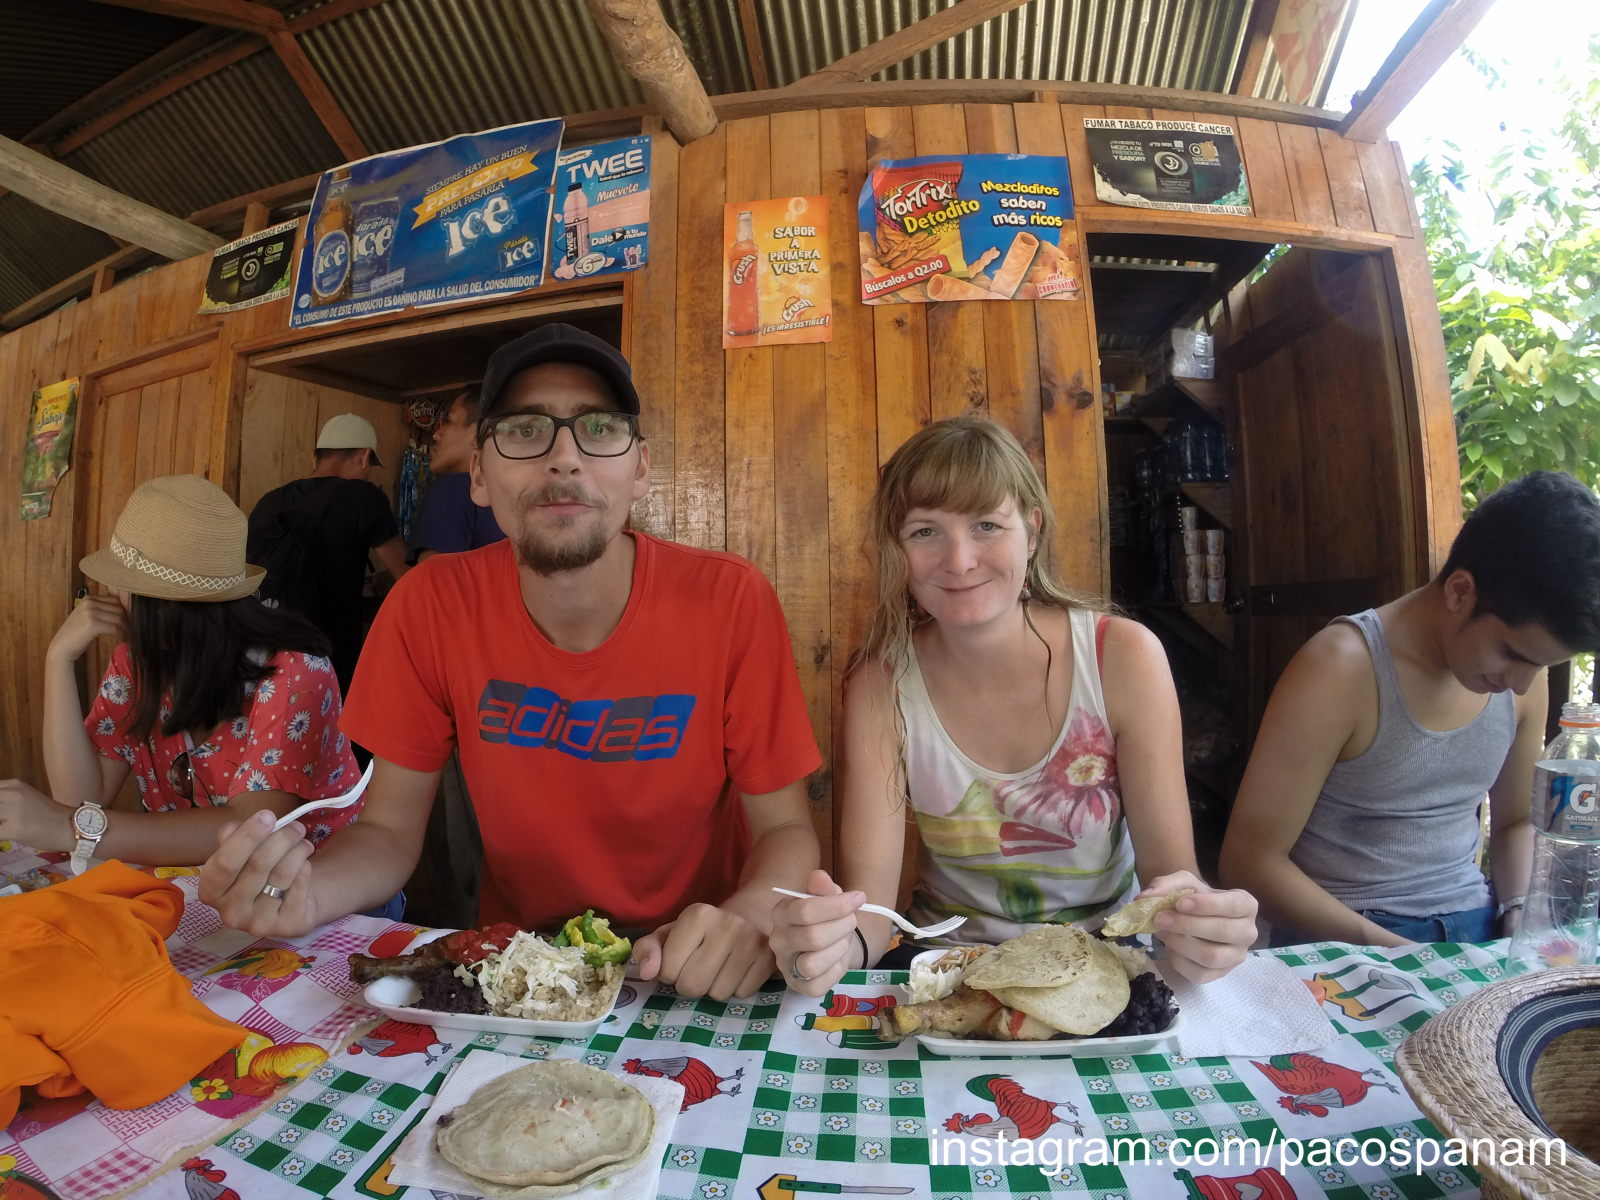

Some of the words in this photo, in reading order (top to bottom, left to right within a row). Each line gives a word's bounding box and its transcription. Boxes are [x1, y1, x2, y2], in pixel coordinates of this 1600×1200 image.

[1085, 120, 1117, 129] FUMAR
[1119, 121, 1153, 130] TABACO
[1156, 122, 1196, 132] PRODUCE
[1199, 125, 1232, 135] CANCER
[425, 170, 463, 196] SIEMPRE
[465, 160, 487, 176] HAY
[485, 155, 500, 167] UN
[501, 145, 528, 160] BUEN
[566, 149, 643, 183] TWEE
[425, 158, 524, 213] PRETEXTO
[980, 180, 1060, 197] Mezcladitos
[440, 202, 464, 217] PARA
[464, 181, 505, 204] PASARLA
[1000, 197, 1047, 210] saben
[903, 199, 981, 234] Detodito
[992, 213, 1027, 227] más
[1030, 213, 1063, 228] ricos
[591, 235, 614, 247] Dale
[774, 226, 816, 239] SABOR
[790, 239, 800, 249] A
[769, 249, 821, 262] PRIMERA
[772, 262, 819, 275] VISTA
[864, 274, 907, 294] Búscalos
[907, 272, 915, 280] a
[914, 260, 944, 277] Q2.00
[303, 308, 329, 323] CONSUMO
[329, 307, 338, 318] DE
[338, 305, 352, 317] ESTE
[352, 300, 383, 314] PRODUCTO
[383, 298, 392, 308] ES
[418, 288, 434, 301] PARA
[434, 287, 446, 299] LA
[446, 284, 469, 298] SALUD
[469, 282, 483, 295] DEL
[782, 298, 815, 321] Crush
[477, 698, 680, 752] adidas
[1570, 783, 1597, 814] G
